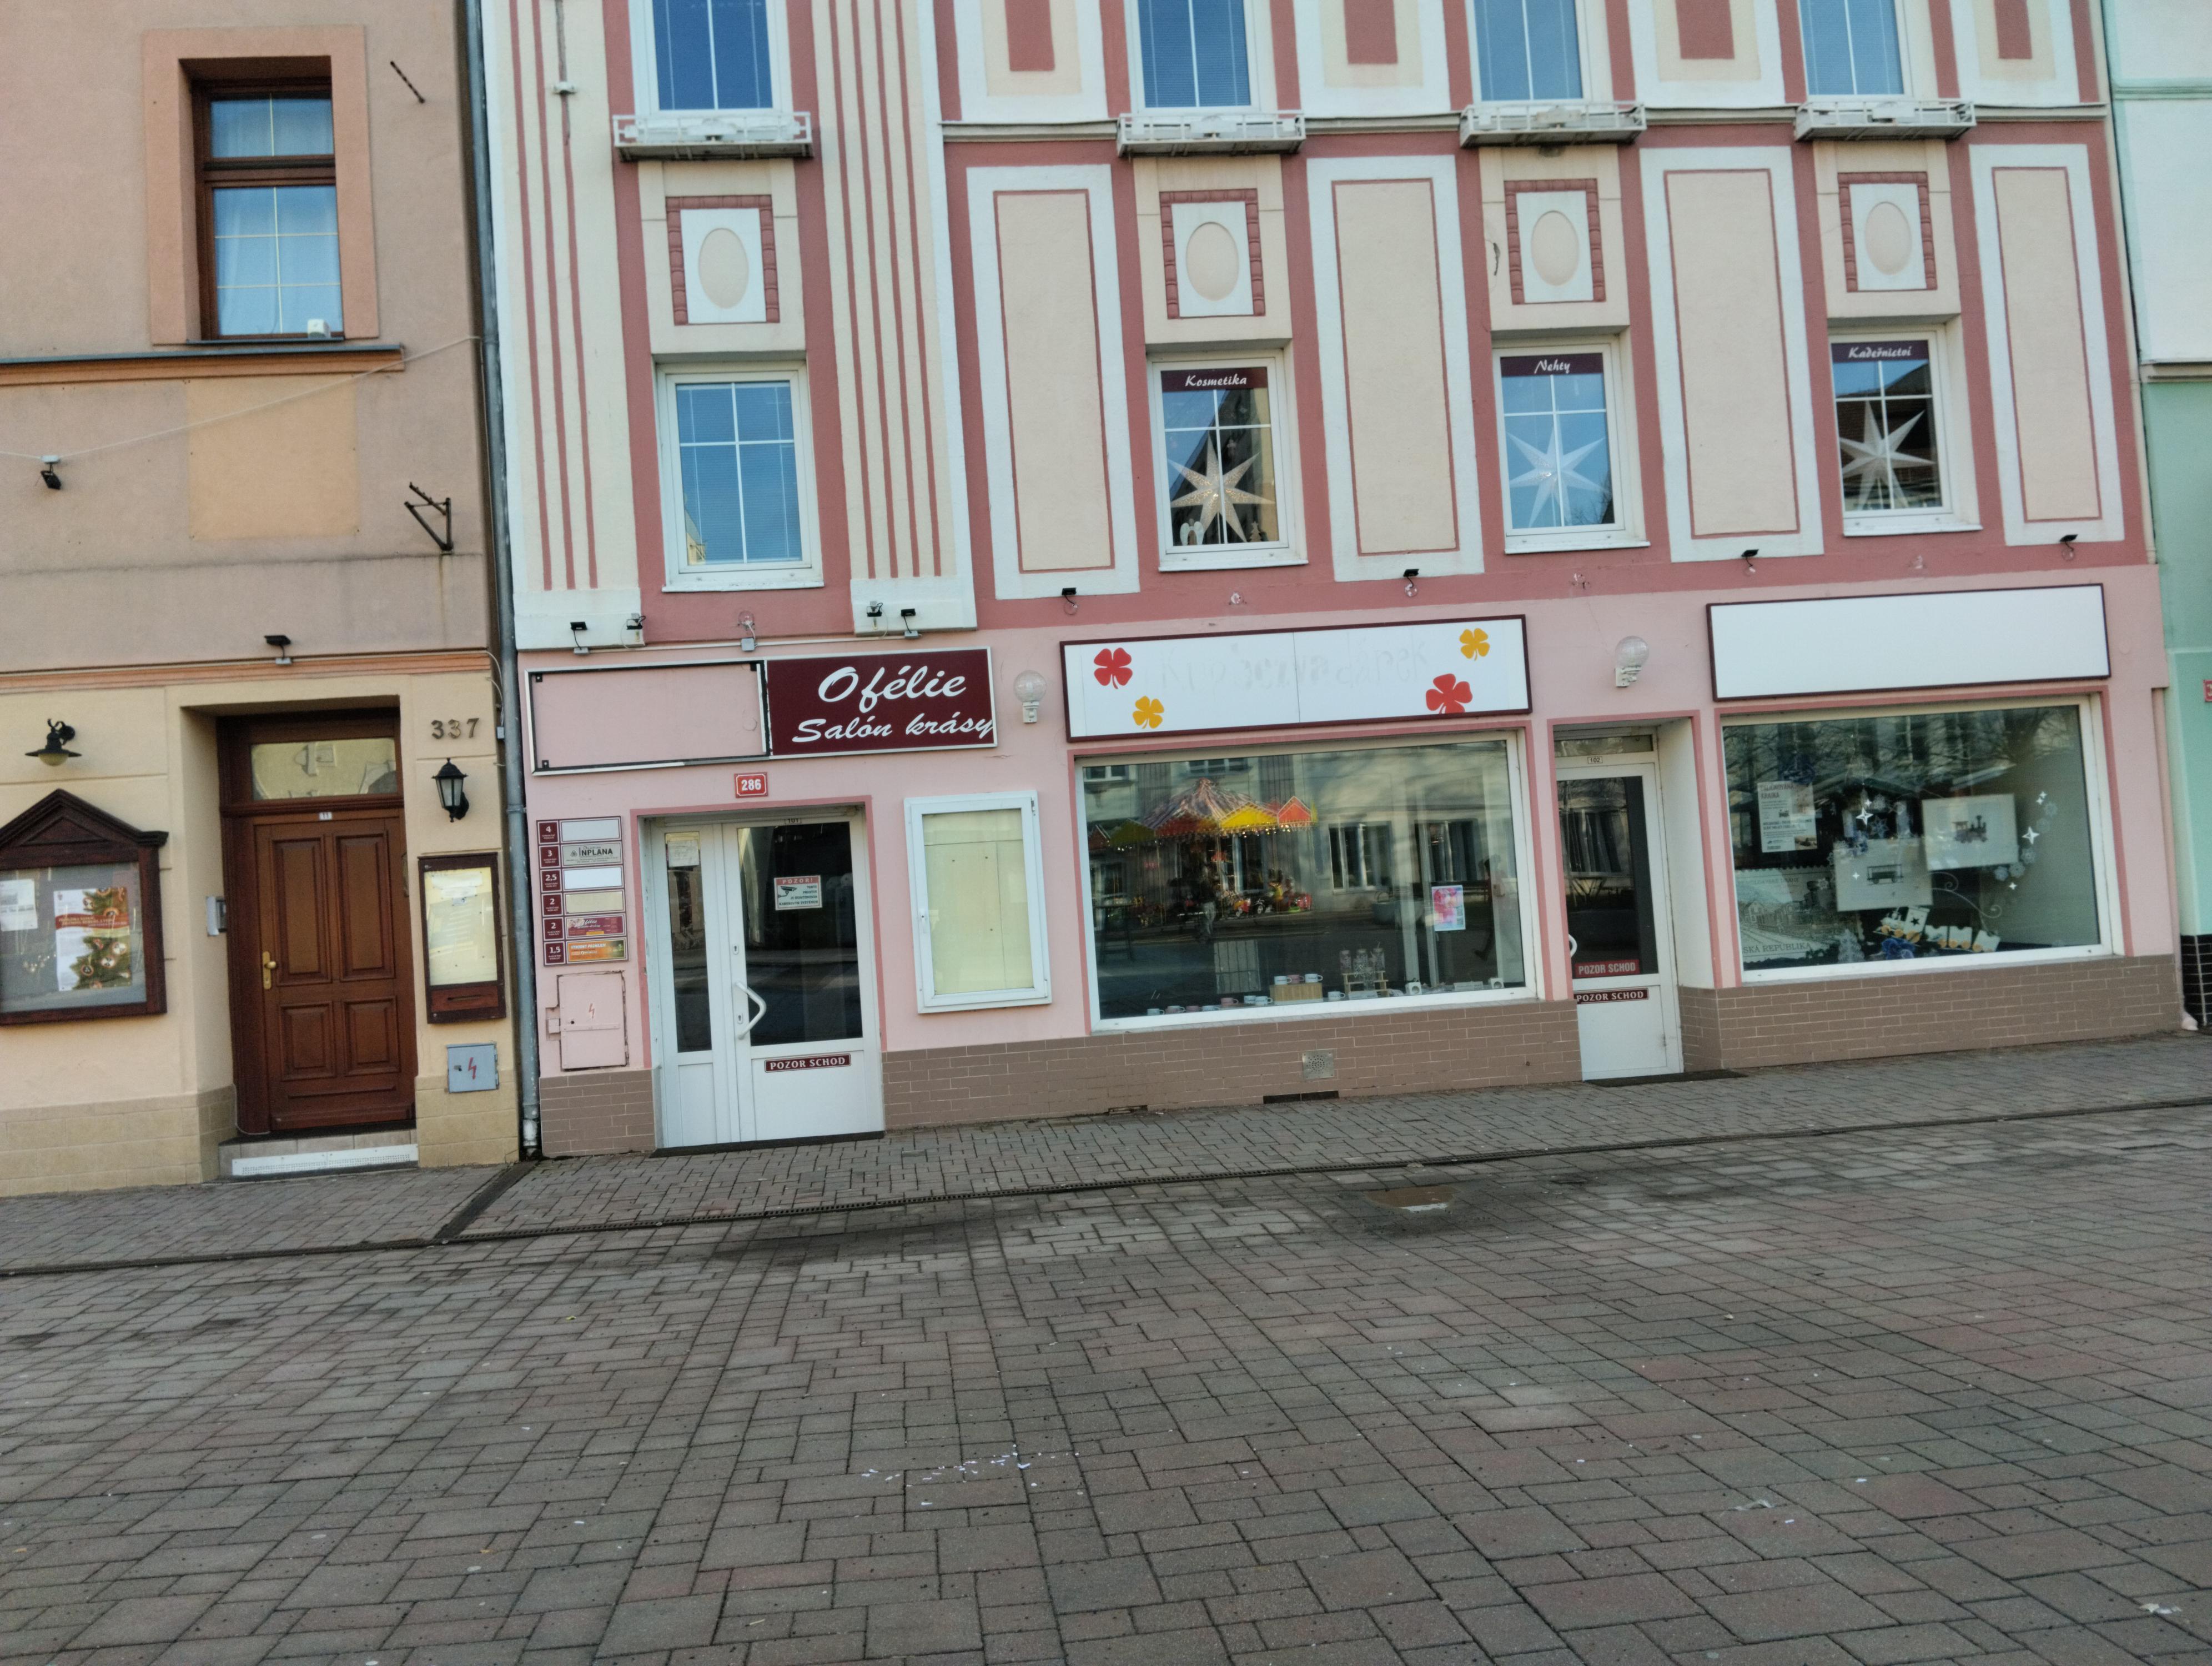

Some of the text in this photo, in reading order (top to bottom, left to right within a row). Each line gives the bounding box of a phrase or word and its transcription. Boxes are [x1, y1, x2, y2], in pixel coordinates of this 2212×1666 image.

[1848, 345, 1912, 358] Kadeřnictví
[1534, 359, 1570, 374] Nehty
[1185, 373, 1247, 387] Kosmetika
[818, 665, 967, 714] Ofélie
[431, 717, 480, 740] 337
[792, 711, 994, 742] Salón krásy
[741, 779, 761, 791] 286
[1742, 942, 1811, 954] SKÁ REPUBLIKA
[1578, 962, 1636, 975] POZOR SCHOD
[1577, 991, 1644, 1002] POZOR SCHOD
[770, 1057, 846, 1070] POZOR SCHOD
